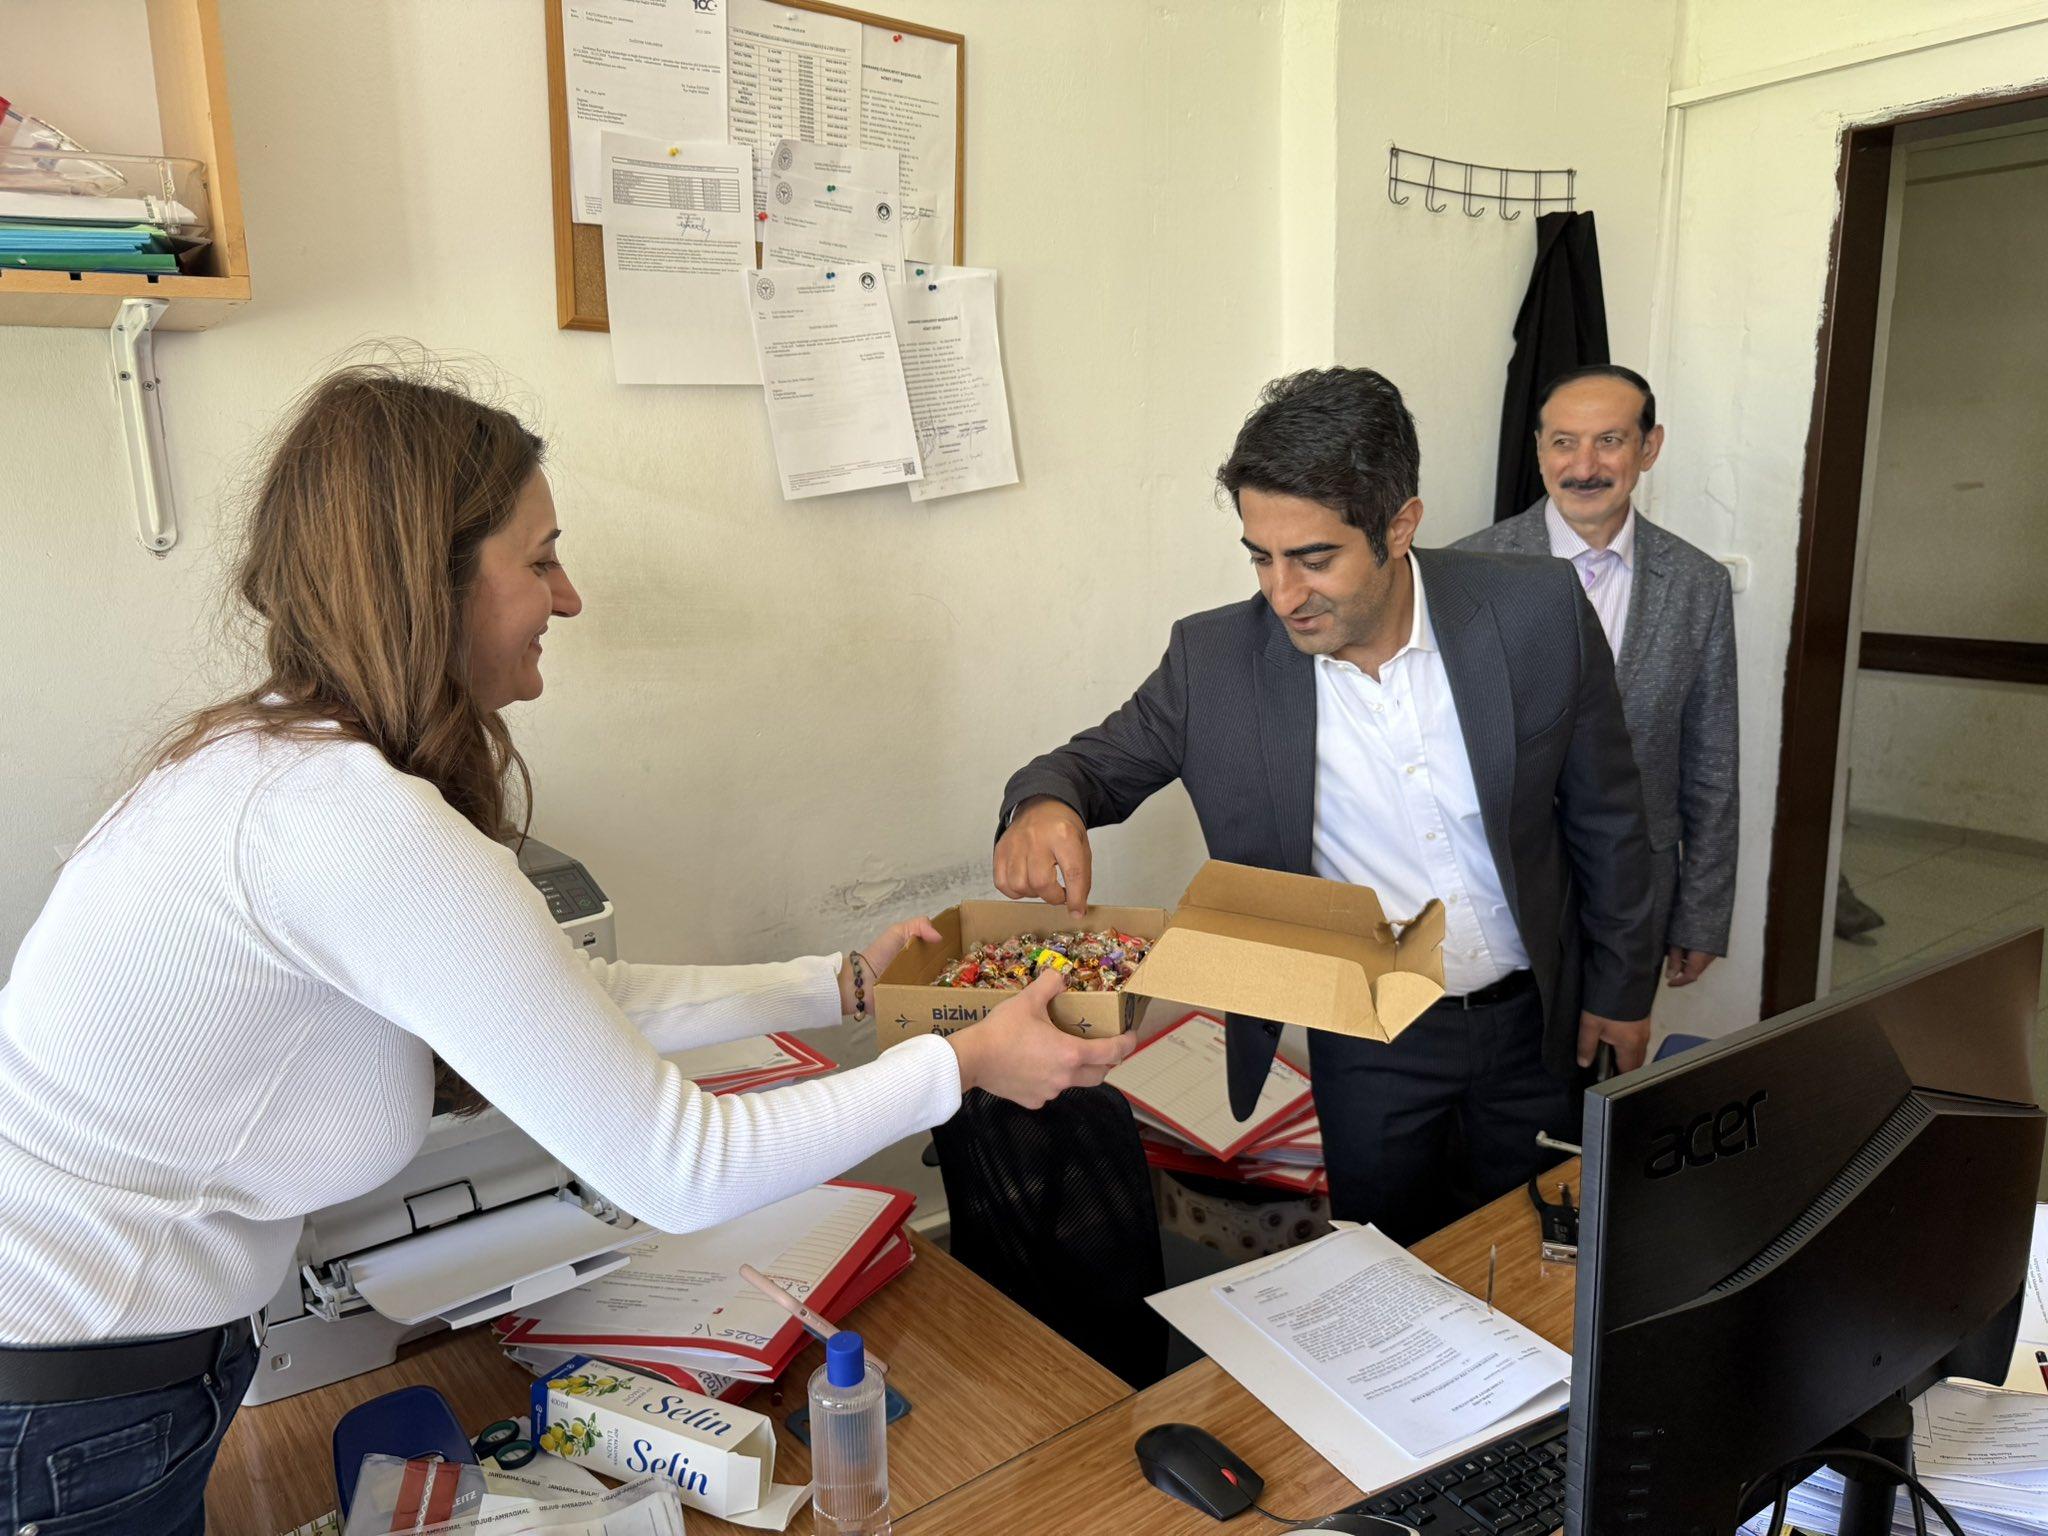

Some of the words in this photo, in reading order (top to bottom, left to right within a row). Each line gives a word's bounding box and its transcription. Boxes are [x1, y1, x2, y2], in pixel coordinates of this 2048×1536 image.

[932, 1004, 978, 1021] BİZİM
[1644, 1087, 1769, 1180] acer
[642, 1395, 732, 1436] Selin
[626, 1438, 708, 1496] Selin
